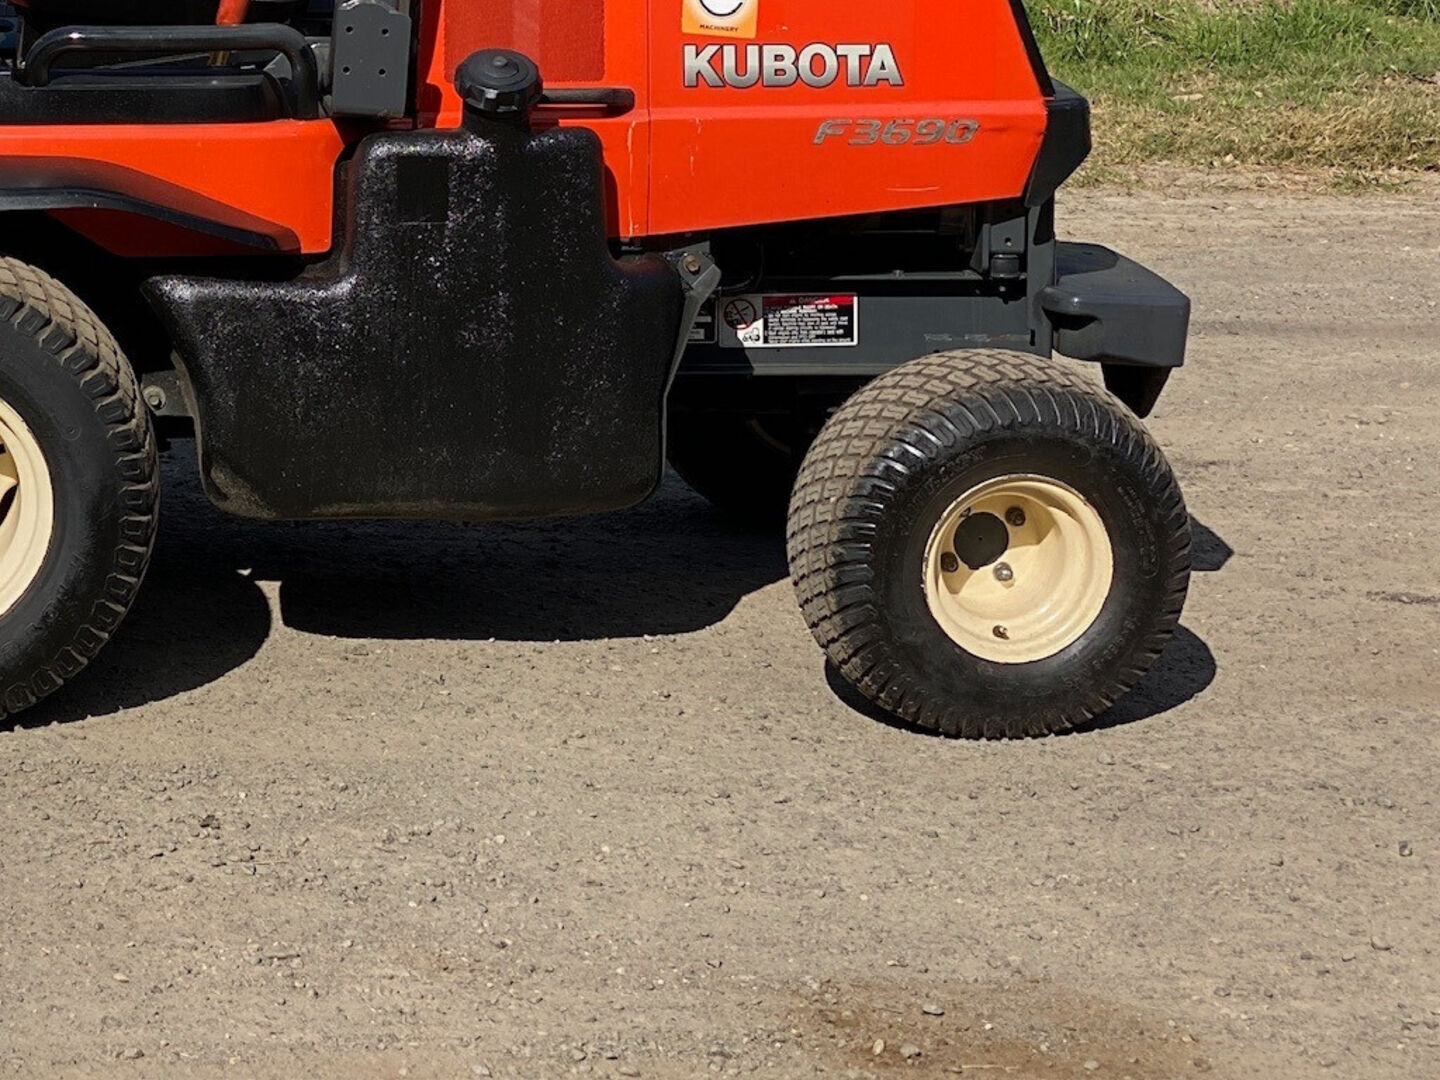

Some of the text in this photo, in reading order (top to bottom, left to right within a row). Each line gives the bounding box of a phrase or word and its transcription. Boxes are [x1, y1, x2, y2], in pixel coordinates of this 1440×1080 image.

[699, 23, 739, 33] MACHINERY
[682, 42, 904, 88] KUBOTA
[812, 118, 980, 146] F3690
